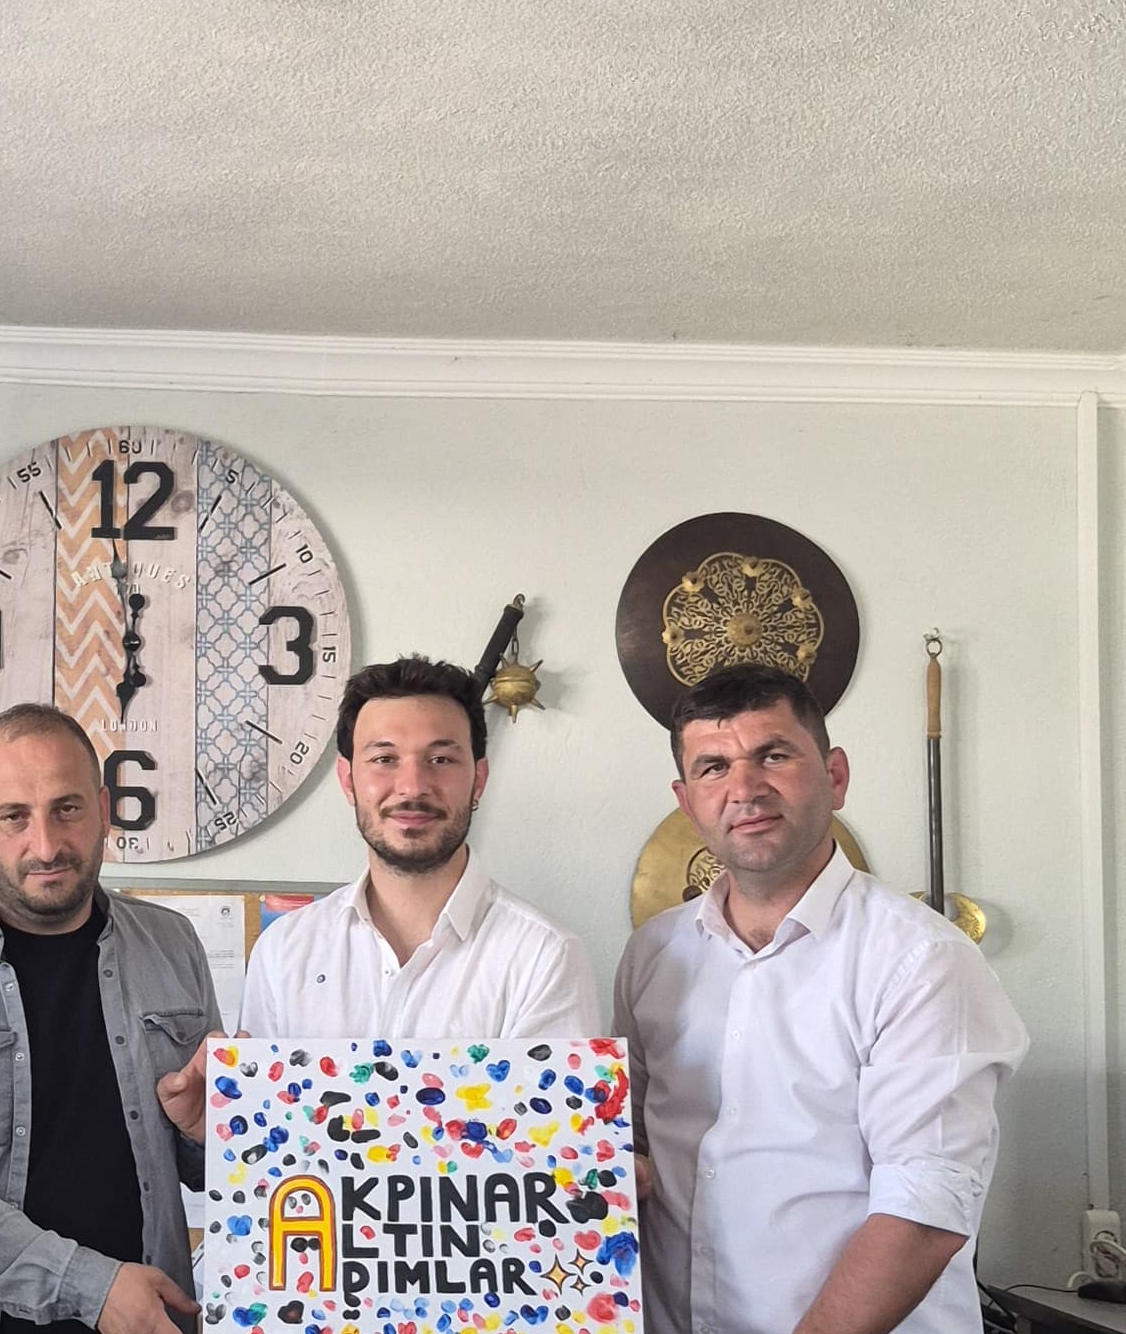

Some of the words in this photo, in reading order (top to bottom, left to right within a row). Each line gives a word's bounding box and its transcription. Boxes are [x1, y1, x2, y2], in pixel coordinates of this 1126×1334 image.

[119, 439, 142, 454] 60
[17, 461, 42, 483] 55
[225, 468, 239, 484] 5
[91, 460, 177, 540] 12
[295, 543, 314, 564] 10
[258, 606, 314, 685] 3
[322, 645, 337, 664] 15
[290, 741, 309, 764] 20
[104, 750, 157, 831] 6
[214, 812, 237, 831] 25
[116, 836, 139, 850] 30
